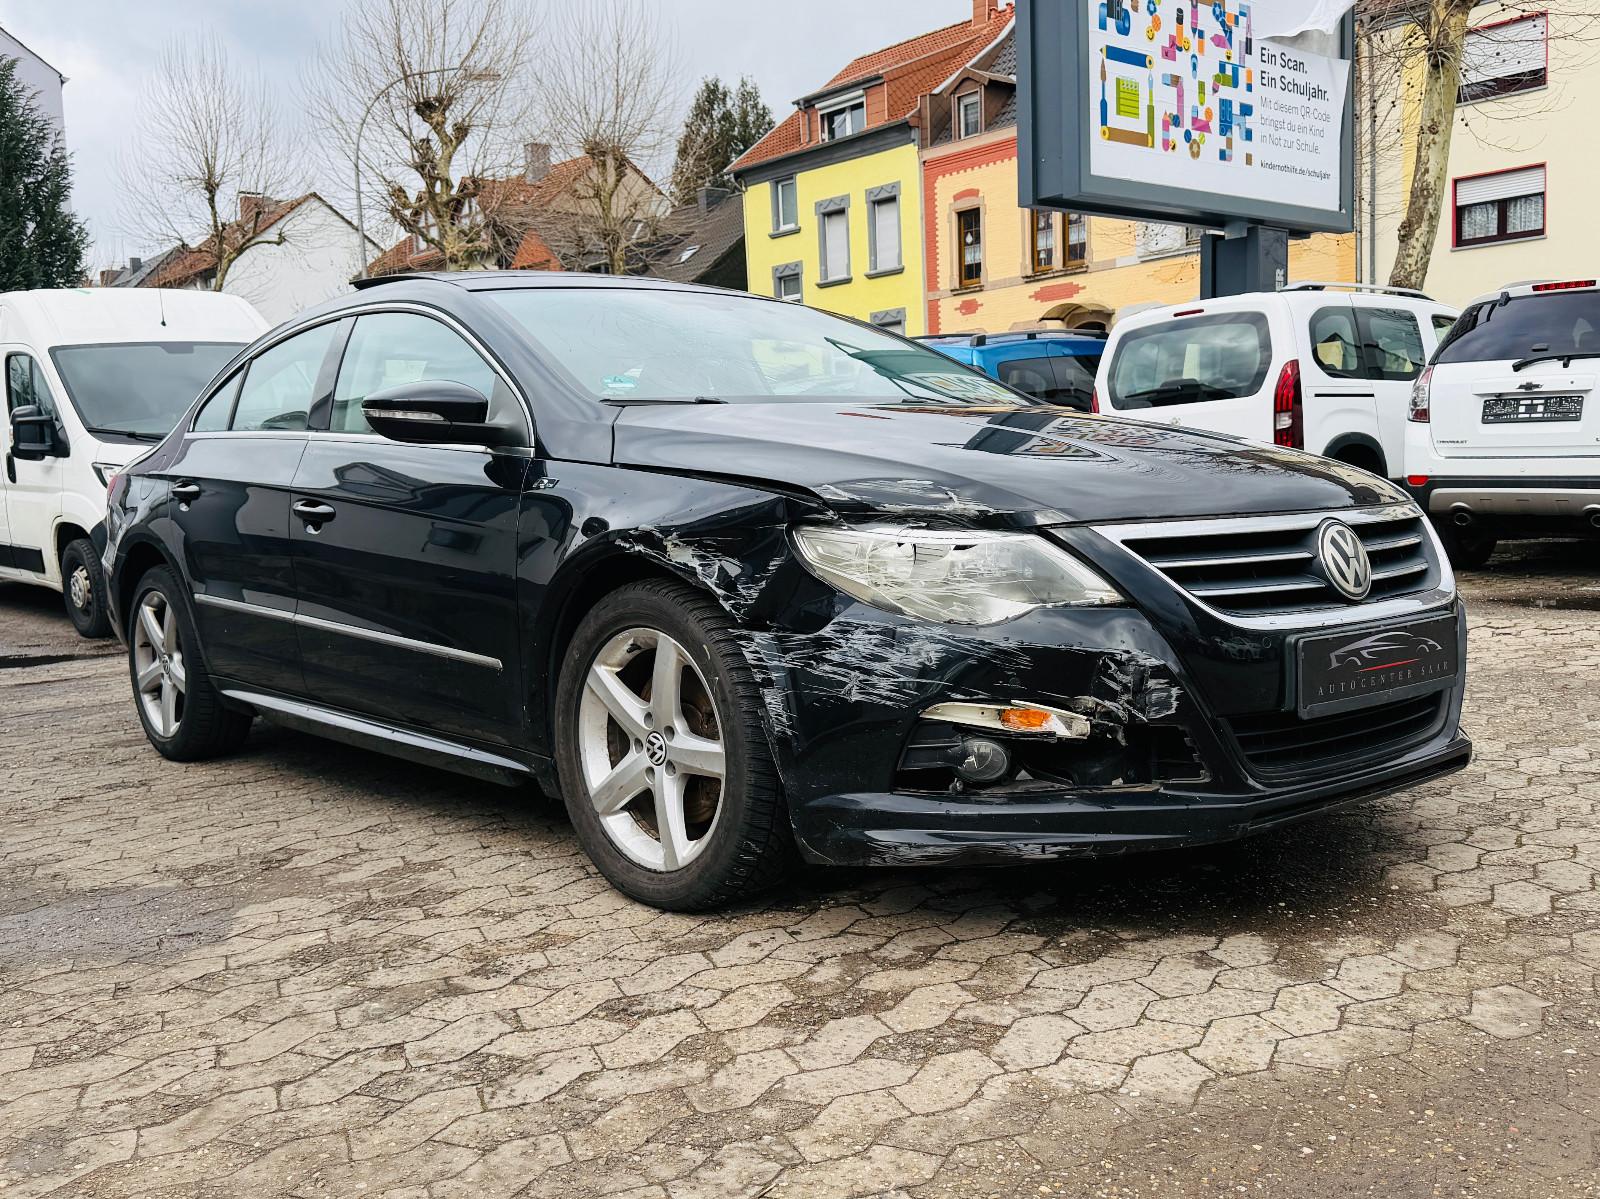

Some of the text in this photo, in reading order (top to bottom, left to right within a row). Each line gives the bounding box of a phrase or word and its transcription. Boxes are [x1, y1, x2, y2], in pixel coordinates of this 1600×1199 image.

[1260, 46, 1308, 74] Ein Scan.
[1260, 70, 1329, 102] Ein Schuljahr.
[1260, 95, 1331, 122] Mit diesem QR-Code
[1260, 114, 1325, 138] bringst du ein Kind
[1260, 132, 1321, 155] in Not zur Schule.
[1260, 159, 1331, 181] kindernothilfe.de/schuljahr
[1317, 661, 1449, 696] AUTOCENTER SAAR
